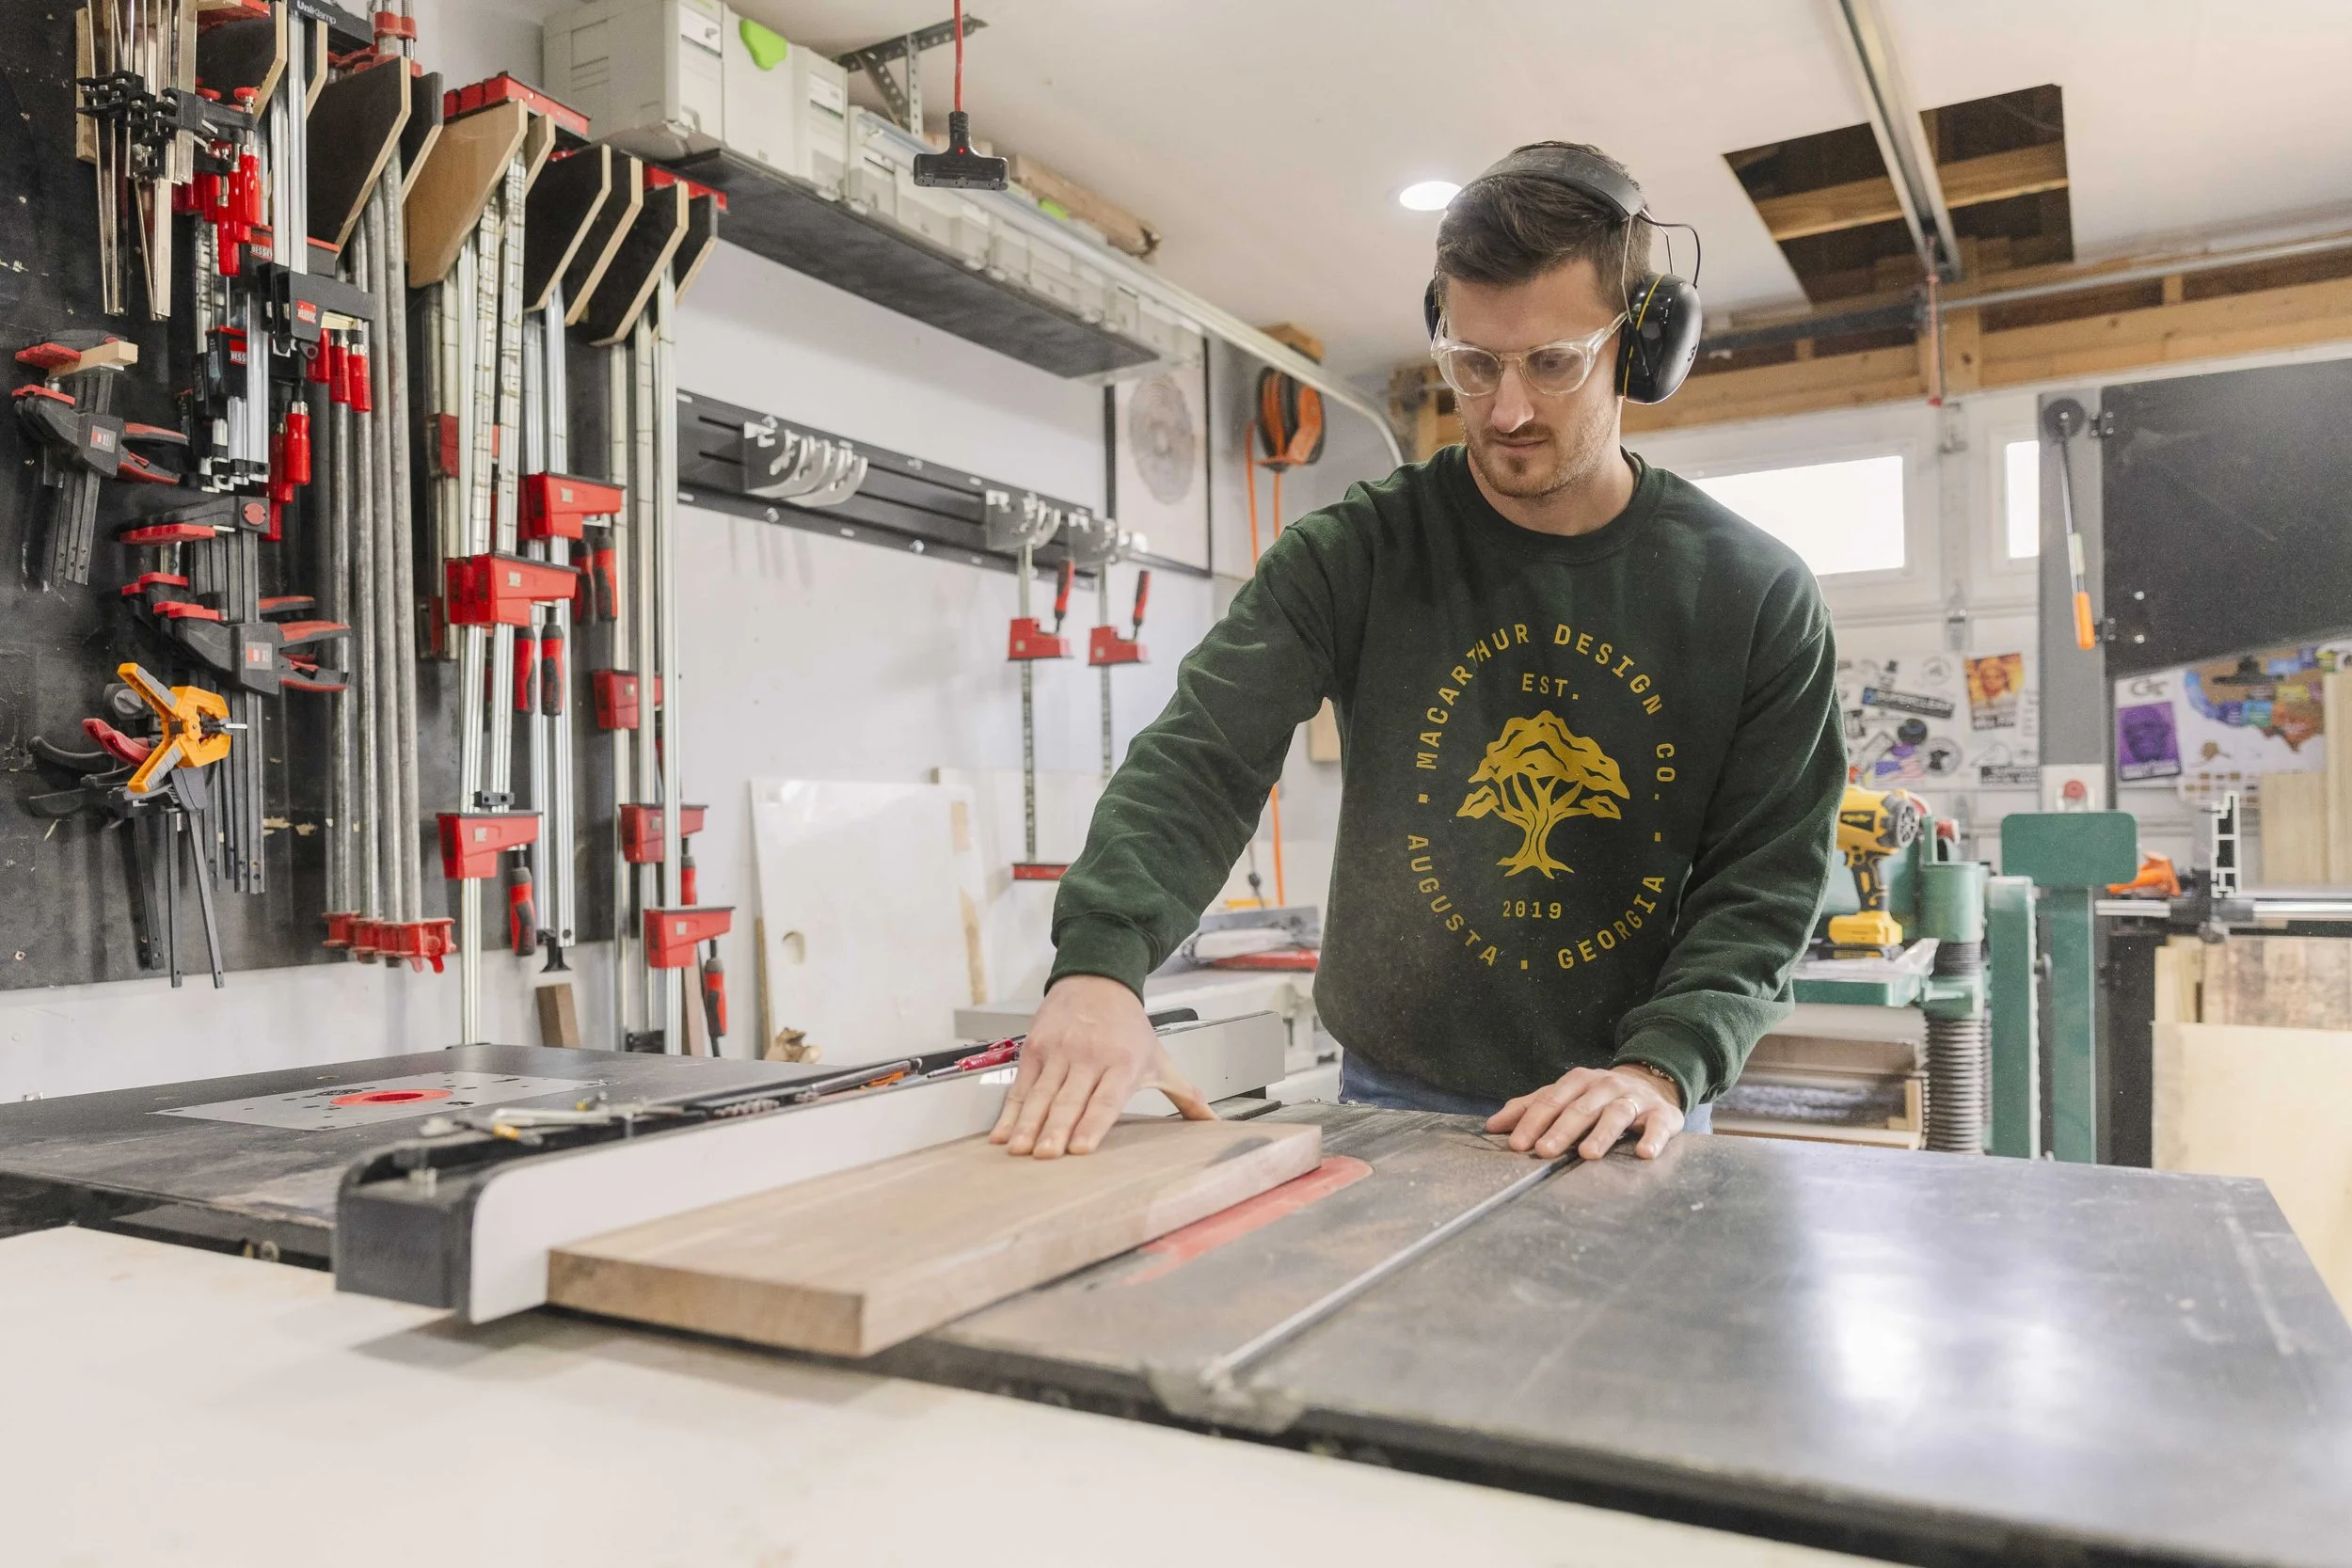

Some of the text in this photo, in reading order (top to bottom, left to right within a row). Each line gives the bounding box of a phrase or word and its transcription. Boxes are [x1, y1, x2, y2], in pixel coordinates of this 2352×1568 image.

[1415, 623, 1676, 800] MACARTHUR DESIGN CO.
[1521, 673, 1580, 700] EST.
[1407, 833, 1666, 970] AUGUSTA GEORGIA
[1502, 900, 1562, 920] 2019
